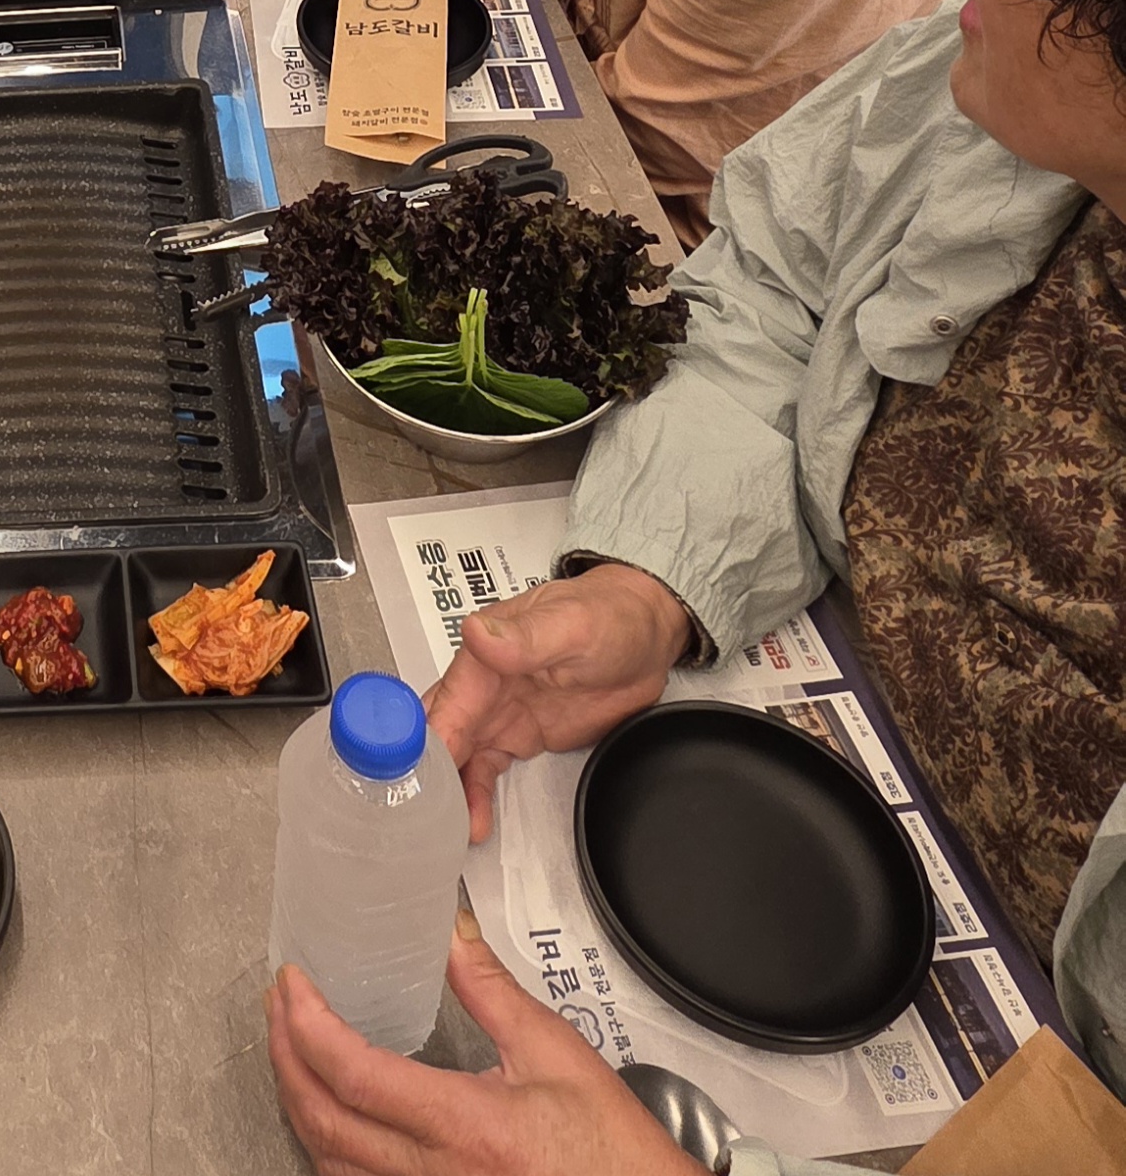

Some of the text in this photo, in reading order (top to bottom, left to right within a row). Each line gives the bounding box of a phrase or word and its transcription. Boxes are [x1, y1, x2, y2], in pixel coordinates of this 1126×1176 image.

[345, 19, 438, 38] 남도갈비
[416, 542, 464, 612] 영수증
[952, 902, 978, 933] 2호점
[529, 928, 581, 1001] 갈비
[582, 946, 612, 997] 전문점
